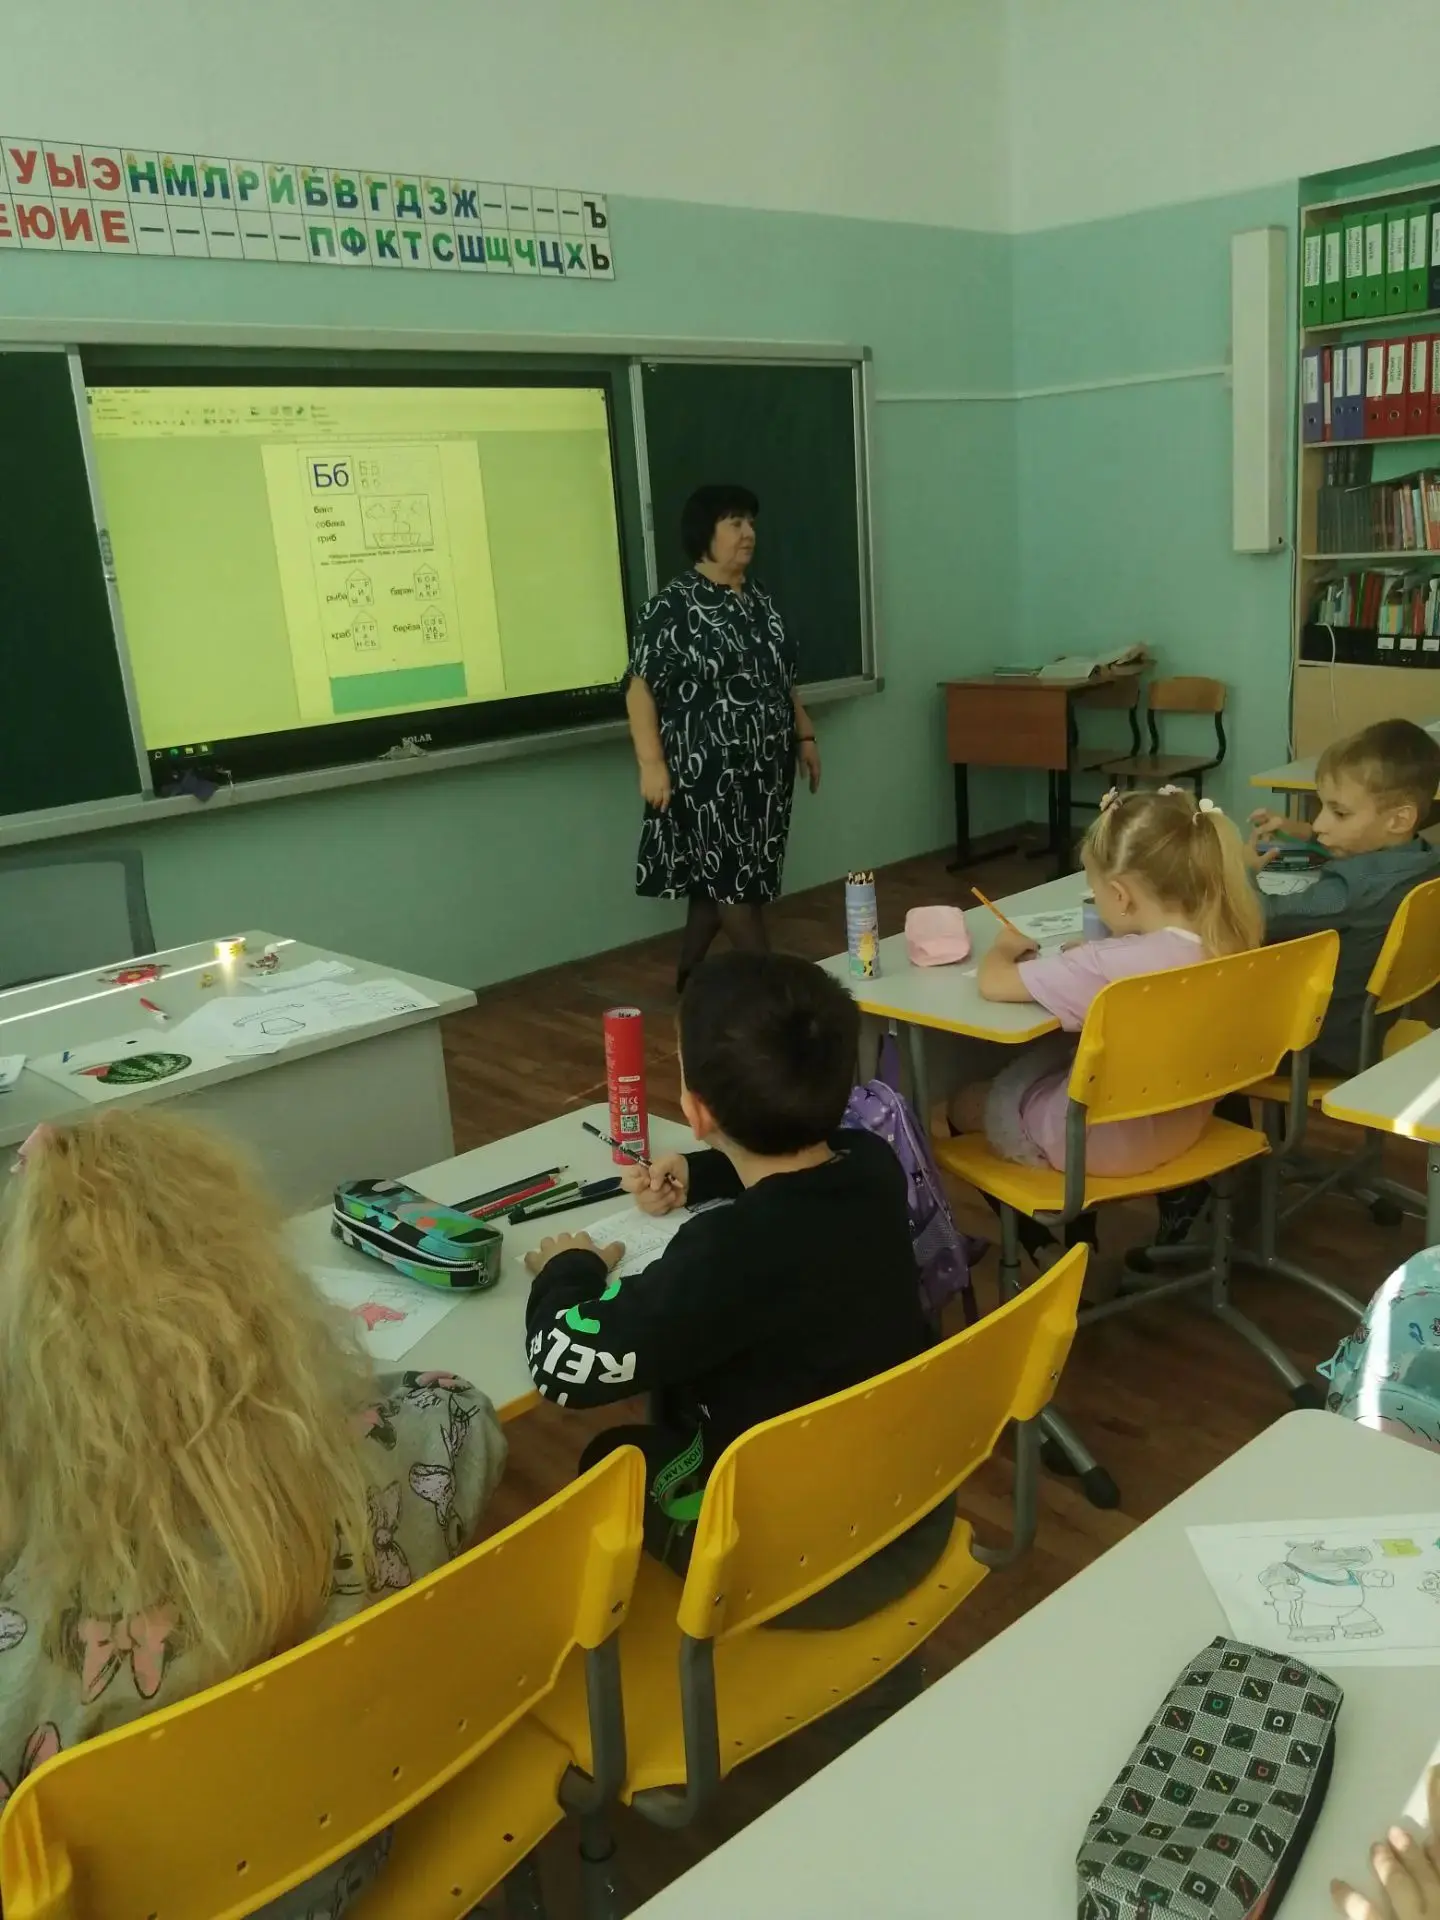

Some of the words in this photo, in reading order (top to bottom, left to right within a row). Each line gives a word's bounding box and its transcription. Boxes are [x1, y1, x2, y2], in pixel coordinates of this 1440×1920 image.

[8, 148, 38, 184] У
[45, 152, 87, 189] Ы
[90, 157, 121, 191] Э
[127, 160, 159, 193] Н
[162, 164, 198, 197] М
[202, 166, 231, 200] Л
[235, 169, 259, 201] Р
[269, 166, 296, 204] Й
[334, 179, 359, 209] В
[369, 181, 388, 212] Г
[397, 183, 422, 219] Д
[428, 186, 448, 216] З
[452, 189, 479, 218] Ж
[583, 201, 607, 229] Ъ
[16, 204, 56, 241] Ю
[59, 207, 94, 242] И
[100, 210, 130, 244] Е
[308, 226, 336, 257] П
[340, 227, 367, 256] Ф
[375, 229, 399, 259] К
[403, 231, 421, 260] Т
[432, 232, 454, 262] С
[458, 234, 485, 263] Ш
[486, 236, 512, 267] Щ
[514, 238, 536, 267] Ч
[538, 240, 563, 274] Ц
[565, 242, 586, 270] Х
[590, 243, 610, 271] Ь
[313, 462, 349, 488] Бб
